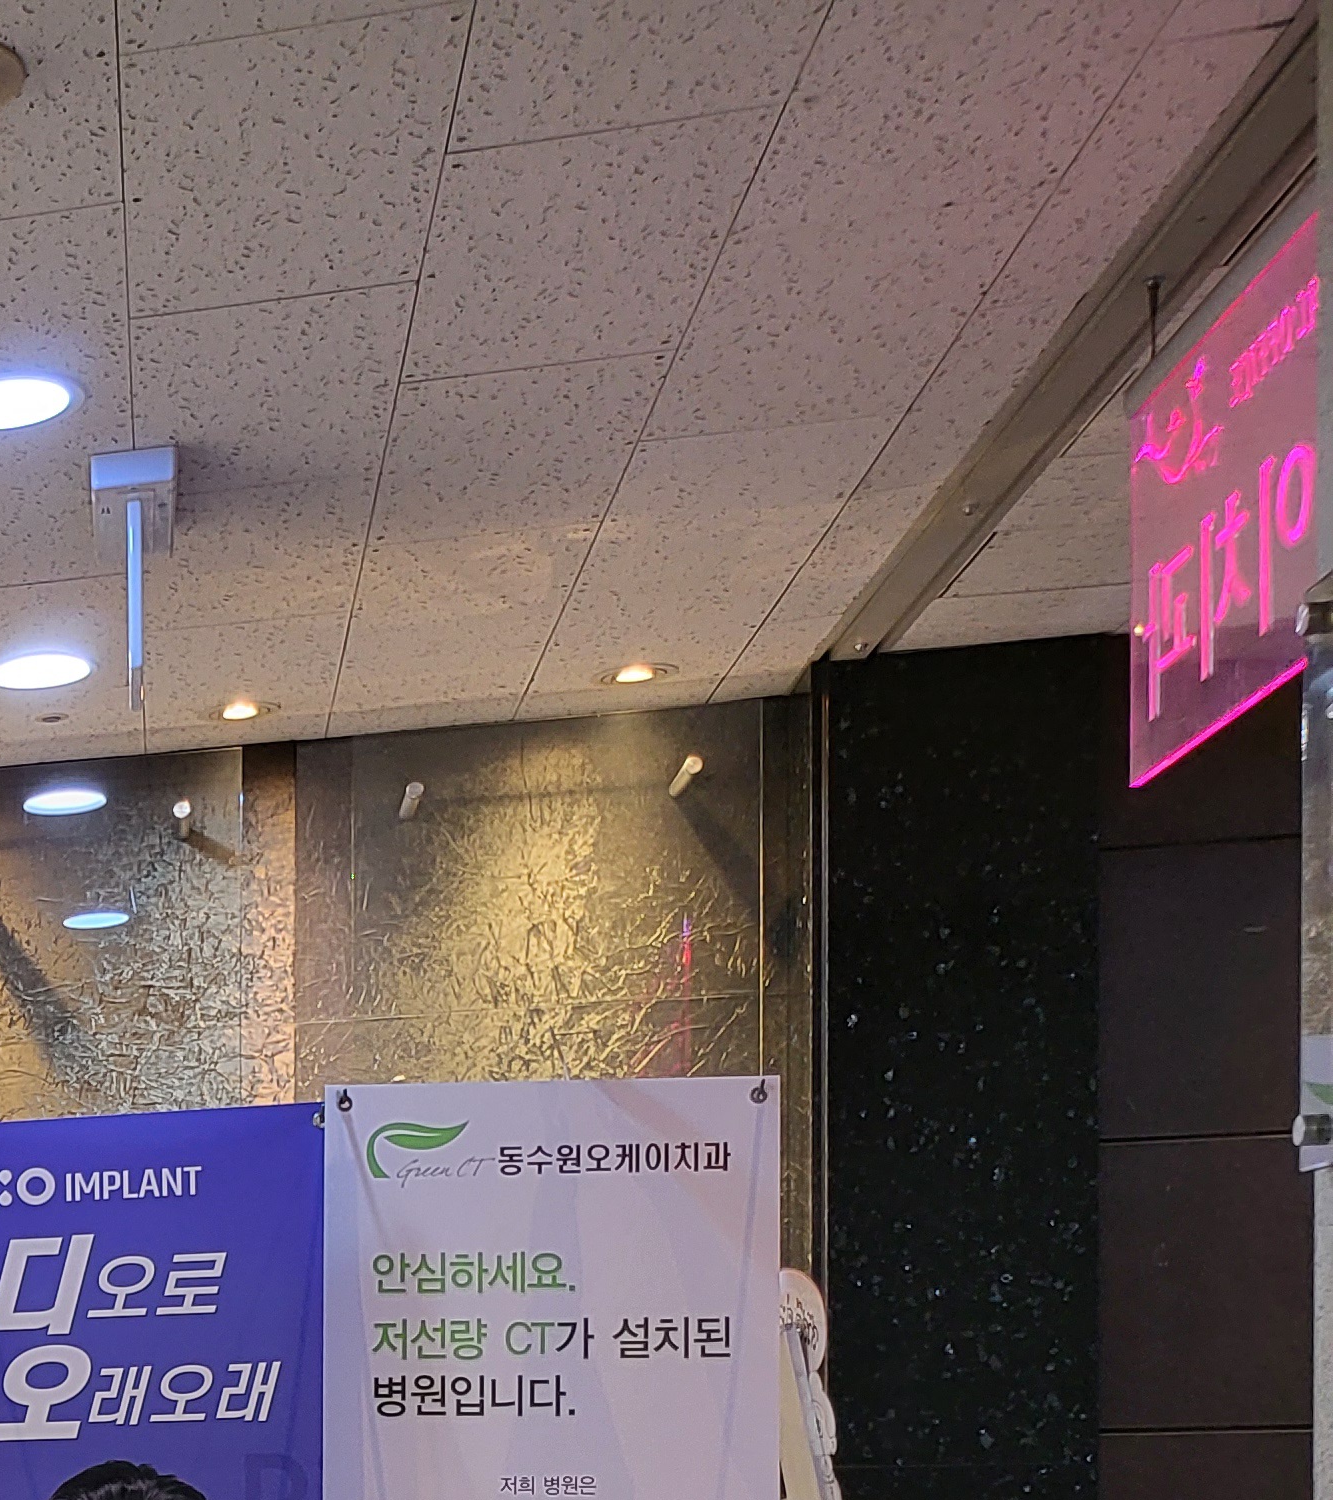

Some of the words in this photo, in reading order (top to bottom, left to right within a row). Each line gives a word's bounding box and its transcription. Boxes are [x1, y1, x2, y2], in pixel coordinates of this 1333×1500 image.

[396, 1158, 453, 1188] Green
[456, 1156, 496, 1179] CT
[497, 1141, 731, 1176] 동수원오케이치과
[65, 1166, 202, 1202] IMPLANT
[372, 1251, 577, 1295] 안심하세요.
[371, 1317, 487, 1361] 저선량
[505, 1317, 594, 1360] CT가
[611, 1315, 731, 1359] 설치된
[373, 1374, 577, 1418] 병원입니다.
[500, 1475, 535, 1496] 저희
[543, 1475, 597, 1496] 병원은
